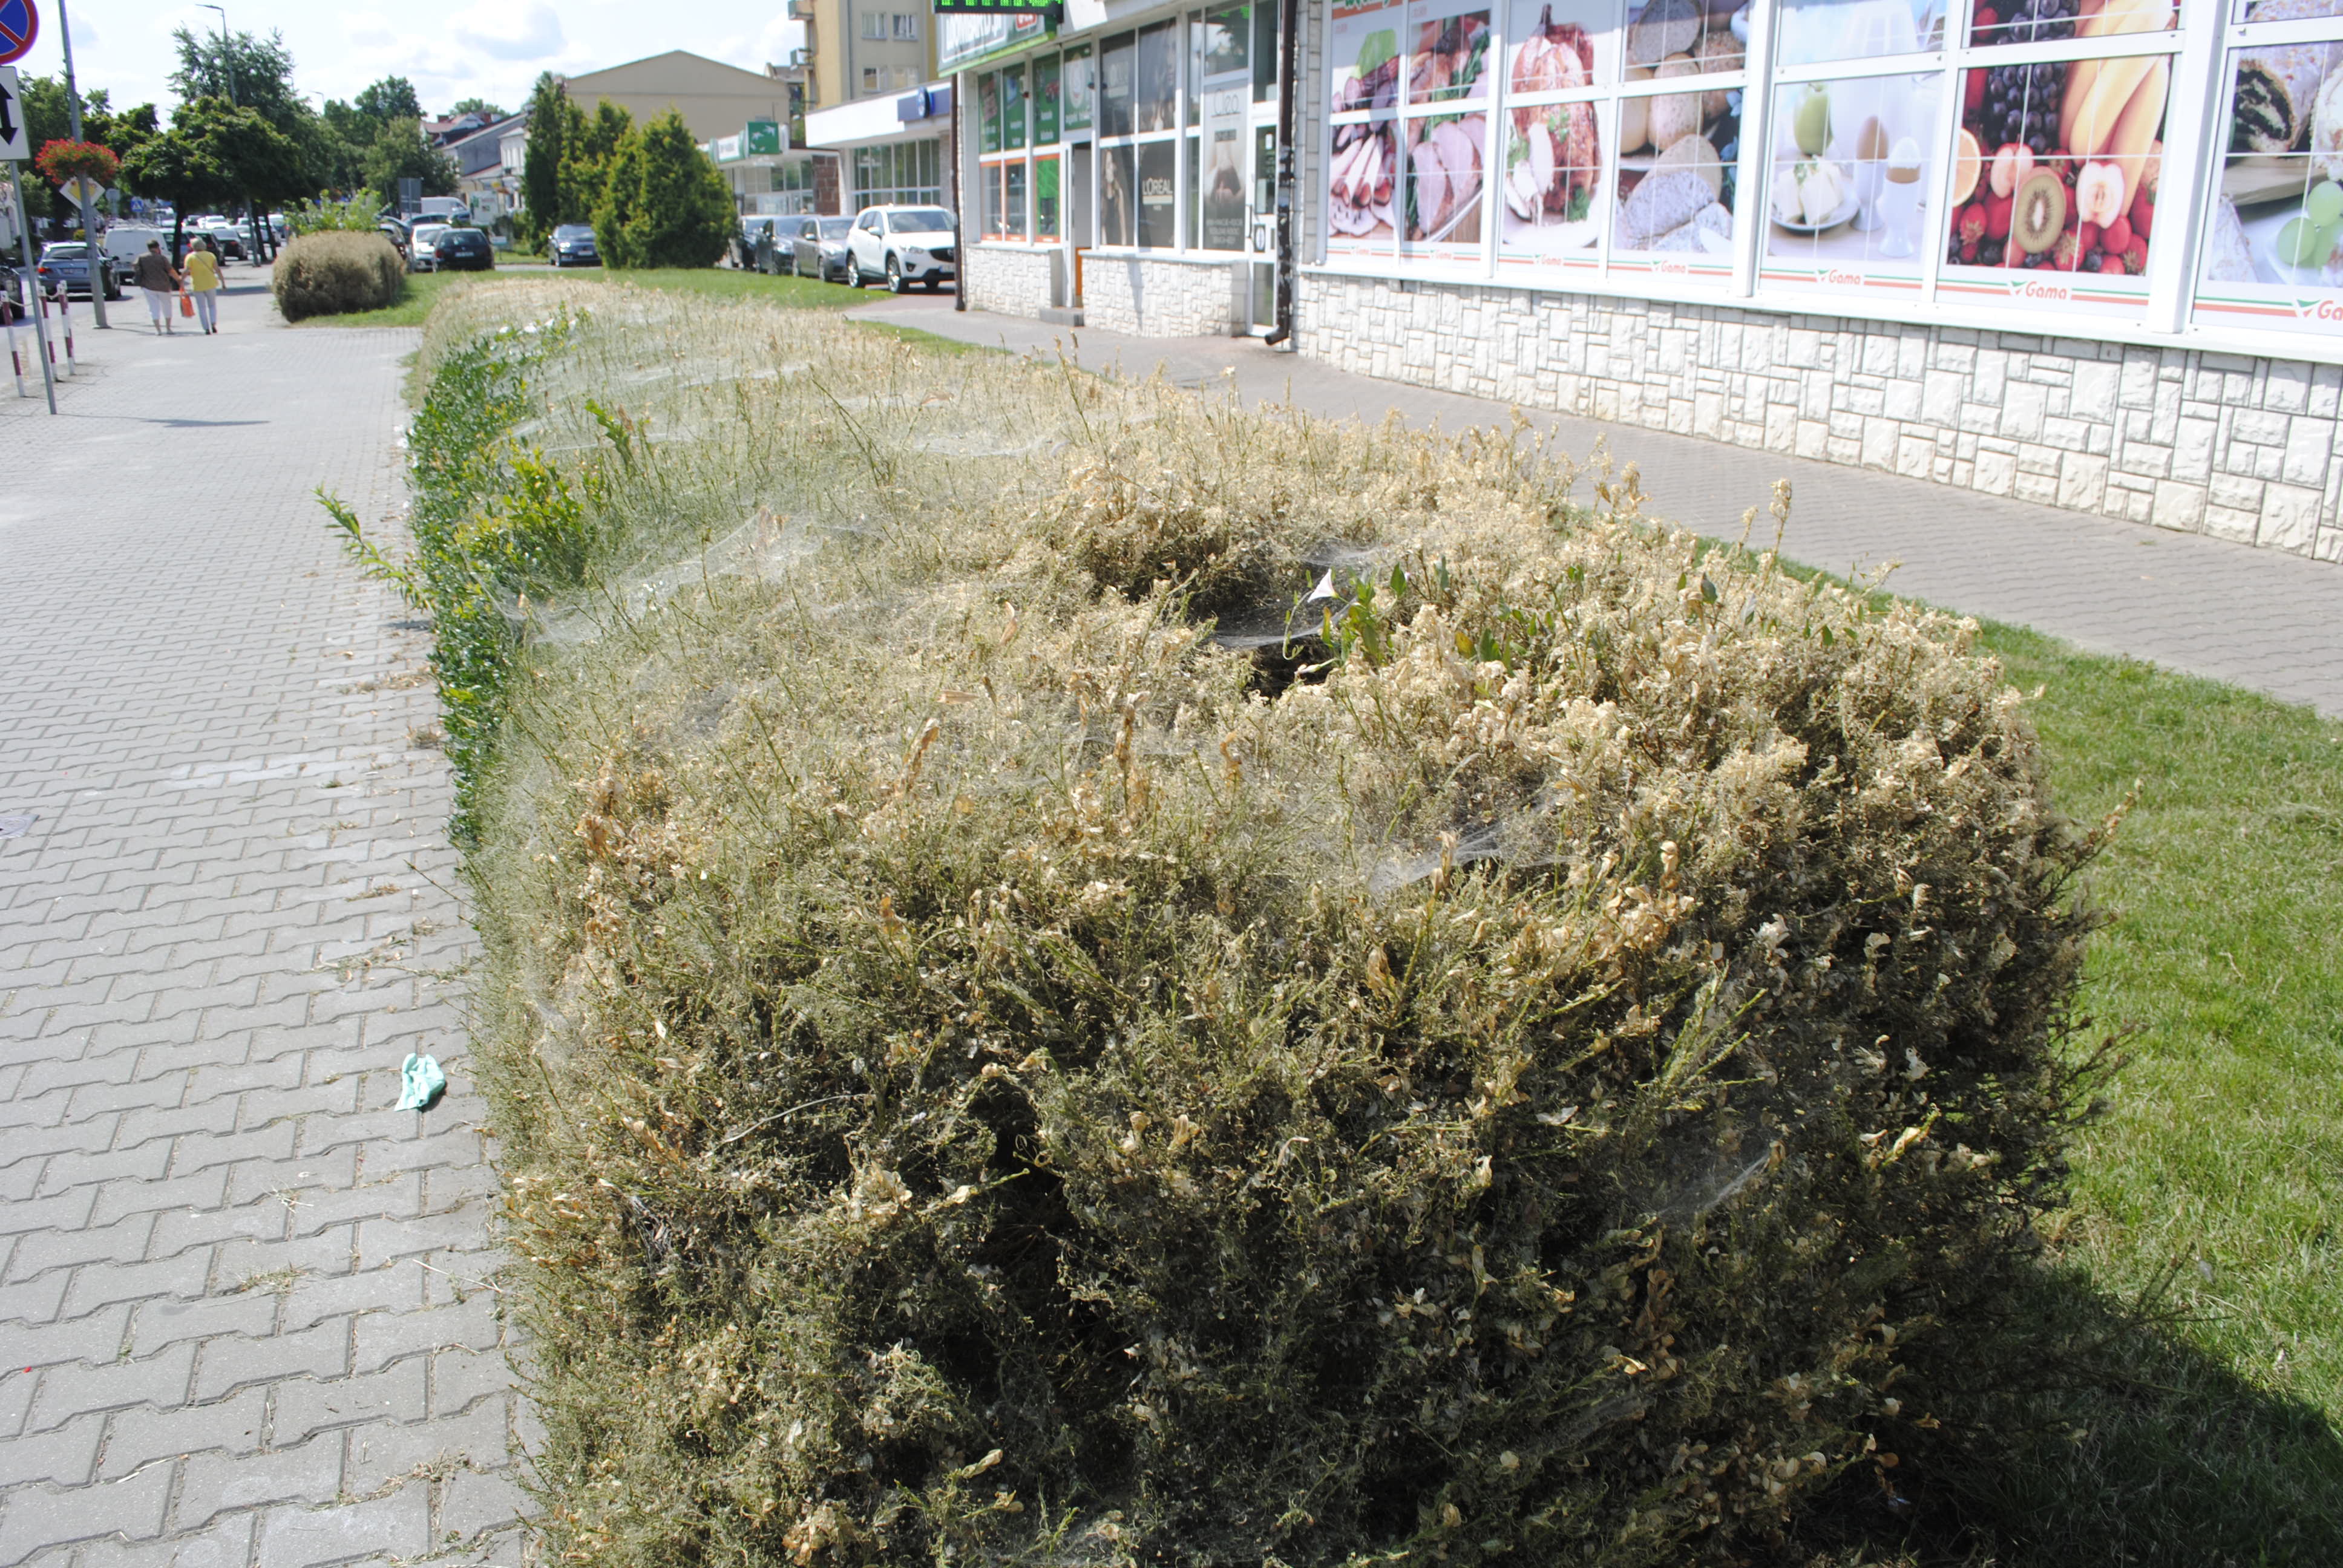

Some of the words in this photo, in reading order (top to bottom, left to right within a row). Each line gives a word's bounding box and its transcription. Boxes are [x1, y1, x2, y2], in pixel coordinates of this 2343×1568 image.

[1661, 261, 1686, 274] Gama
[1829, 269, 1861, 286] Gama
[2025, 281, 2068, 300] Gama
